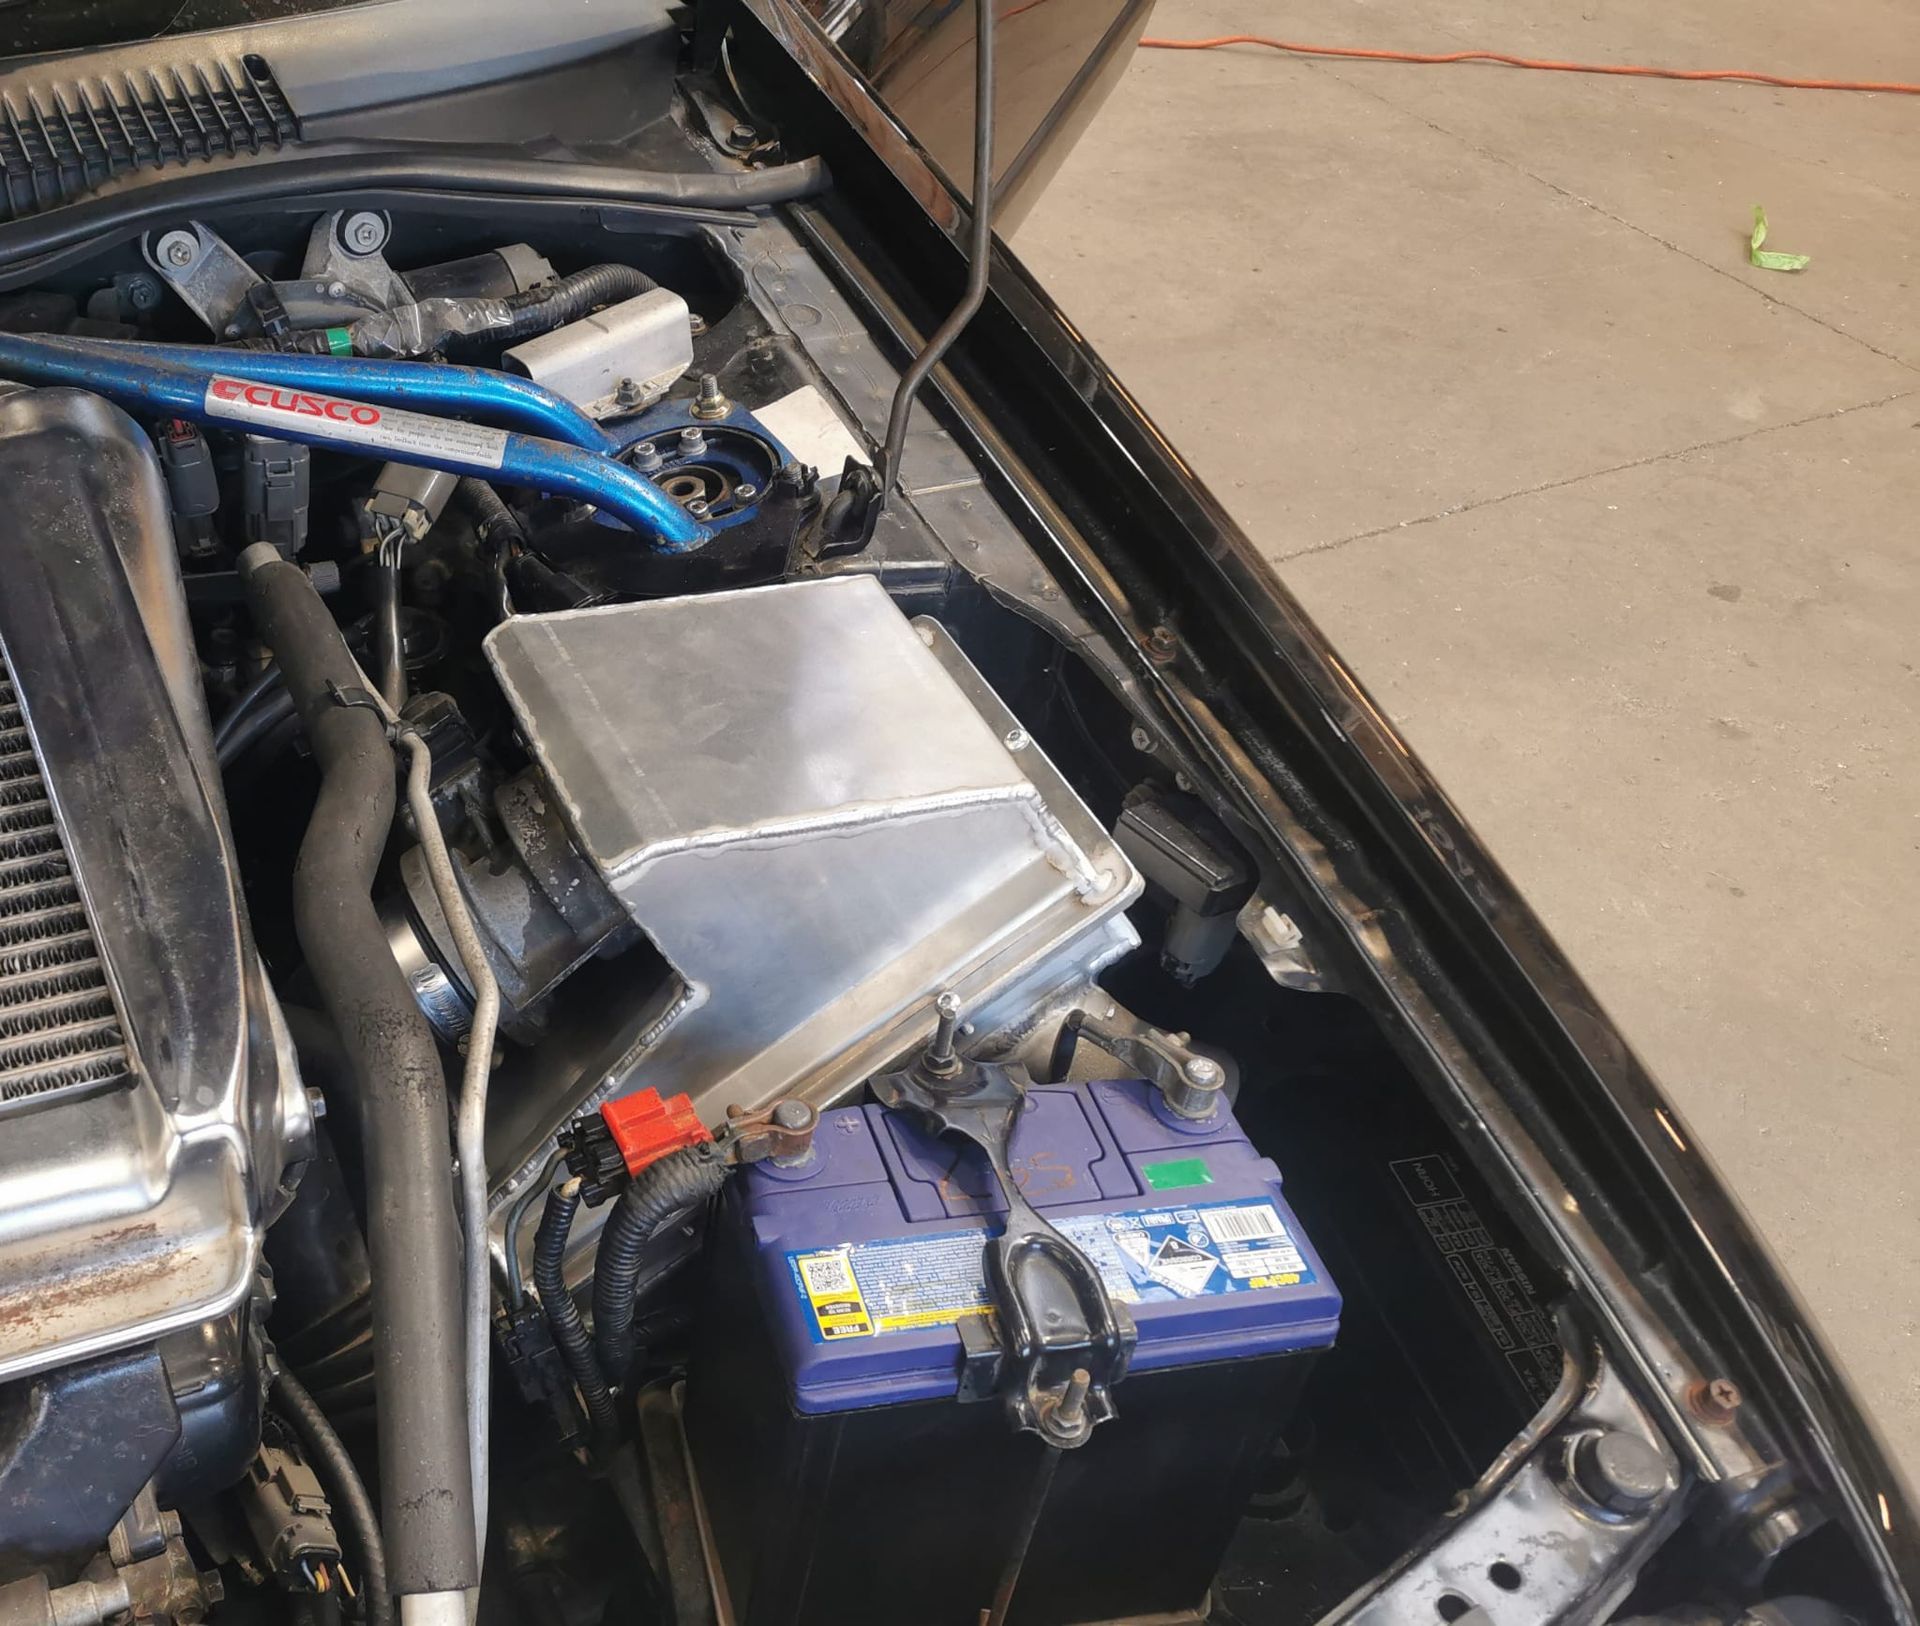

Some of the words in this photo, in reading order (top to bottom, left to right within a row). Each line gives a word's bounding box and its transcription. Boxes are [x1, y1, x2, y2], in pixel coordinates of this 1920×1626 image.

[244, 386, 381, 426] CUSCO
[1412, 1161, 1441, 1198] HORN
[1501, 1247, 1537, 1296] NISSAN
[832, 1324, 860, 1335] FREE
